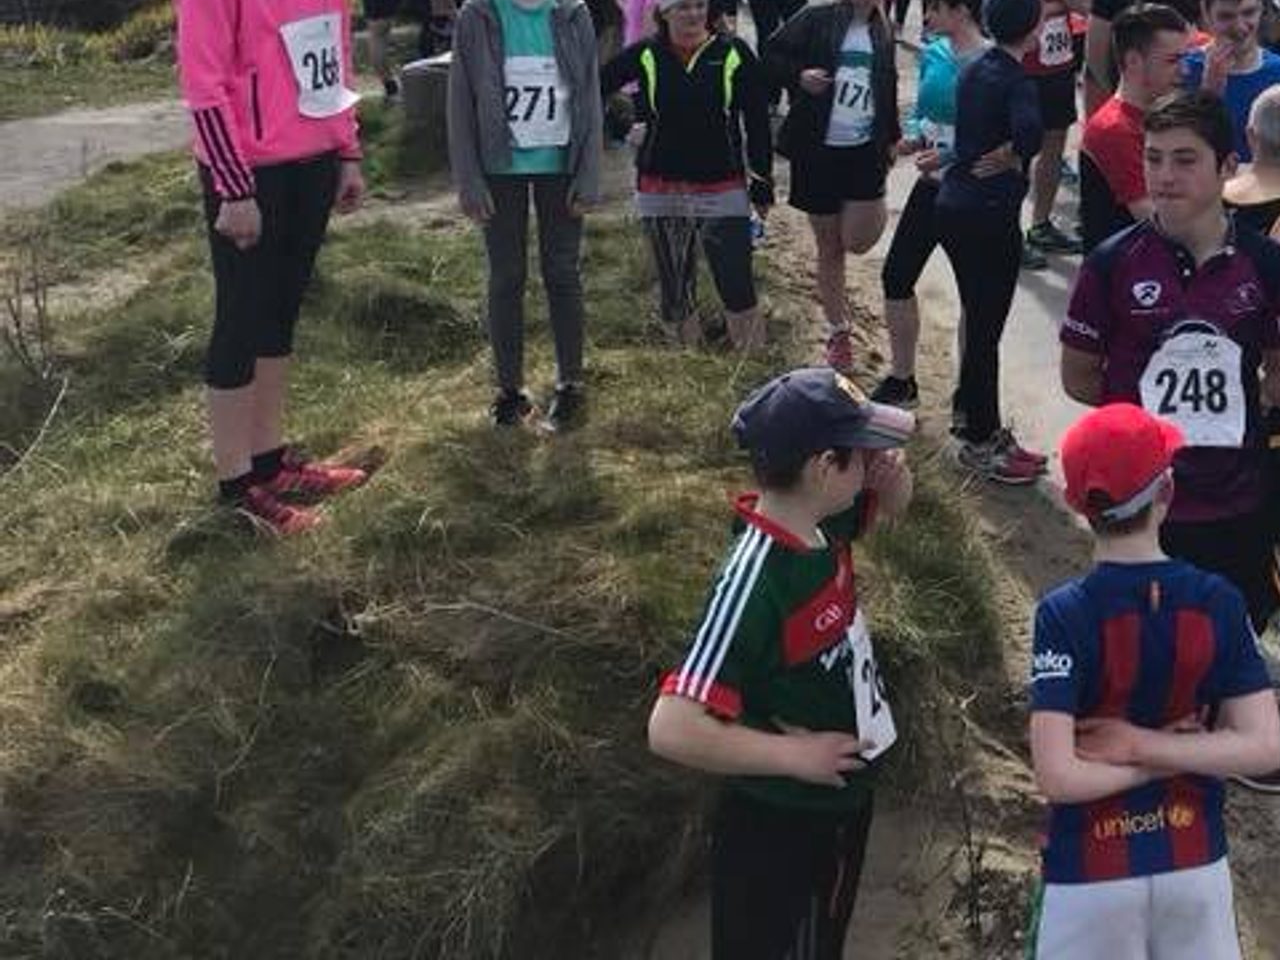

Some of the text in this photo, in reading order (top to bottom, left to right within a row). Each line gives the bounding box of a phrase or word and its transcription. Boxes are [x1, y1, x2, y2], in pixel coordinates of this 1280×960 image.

[505, 85, 556, 122] 271
[1155, 367, 1229, 416] 248
[1034, 649, 1073, 671] eko
[1093, 806, 1164, 840] unicef
